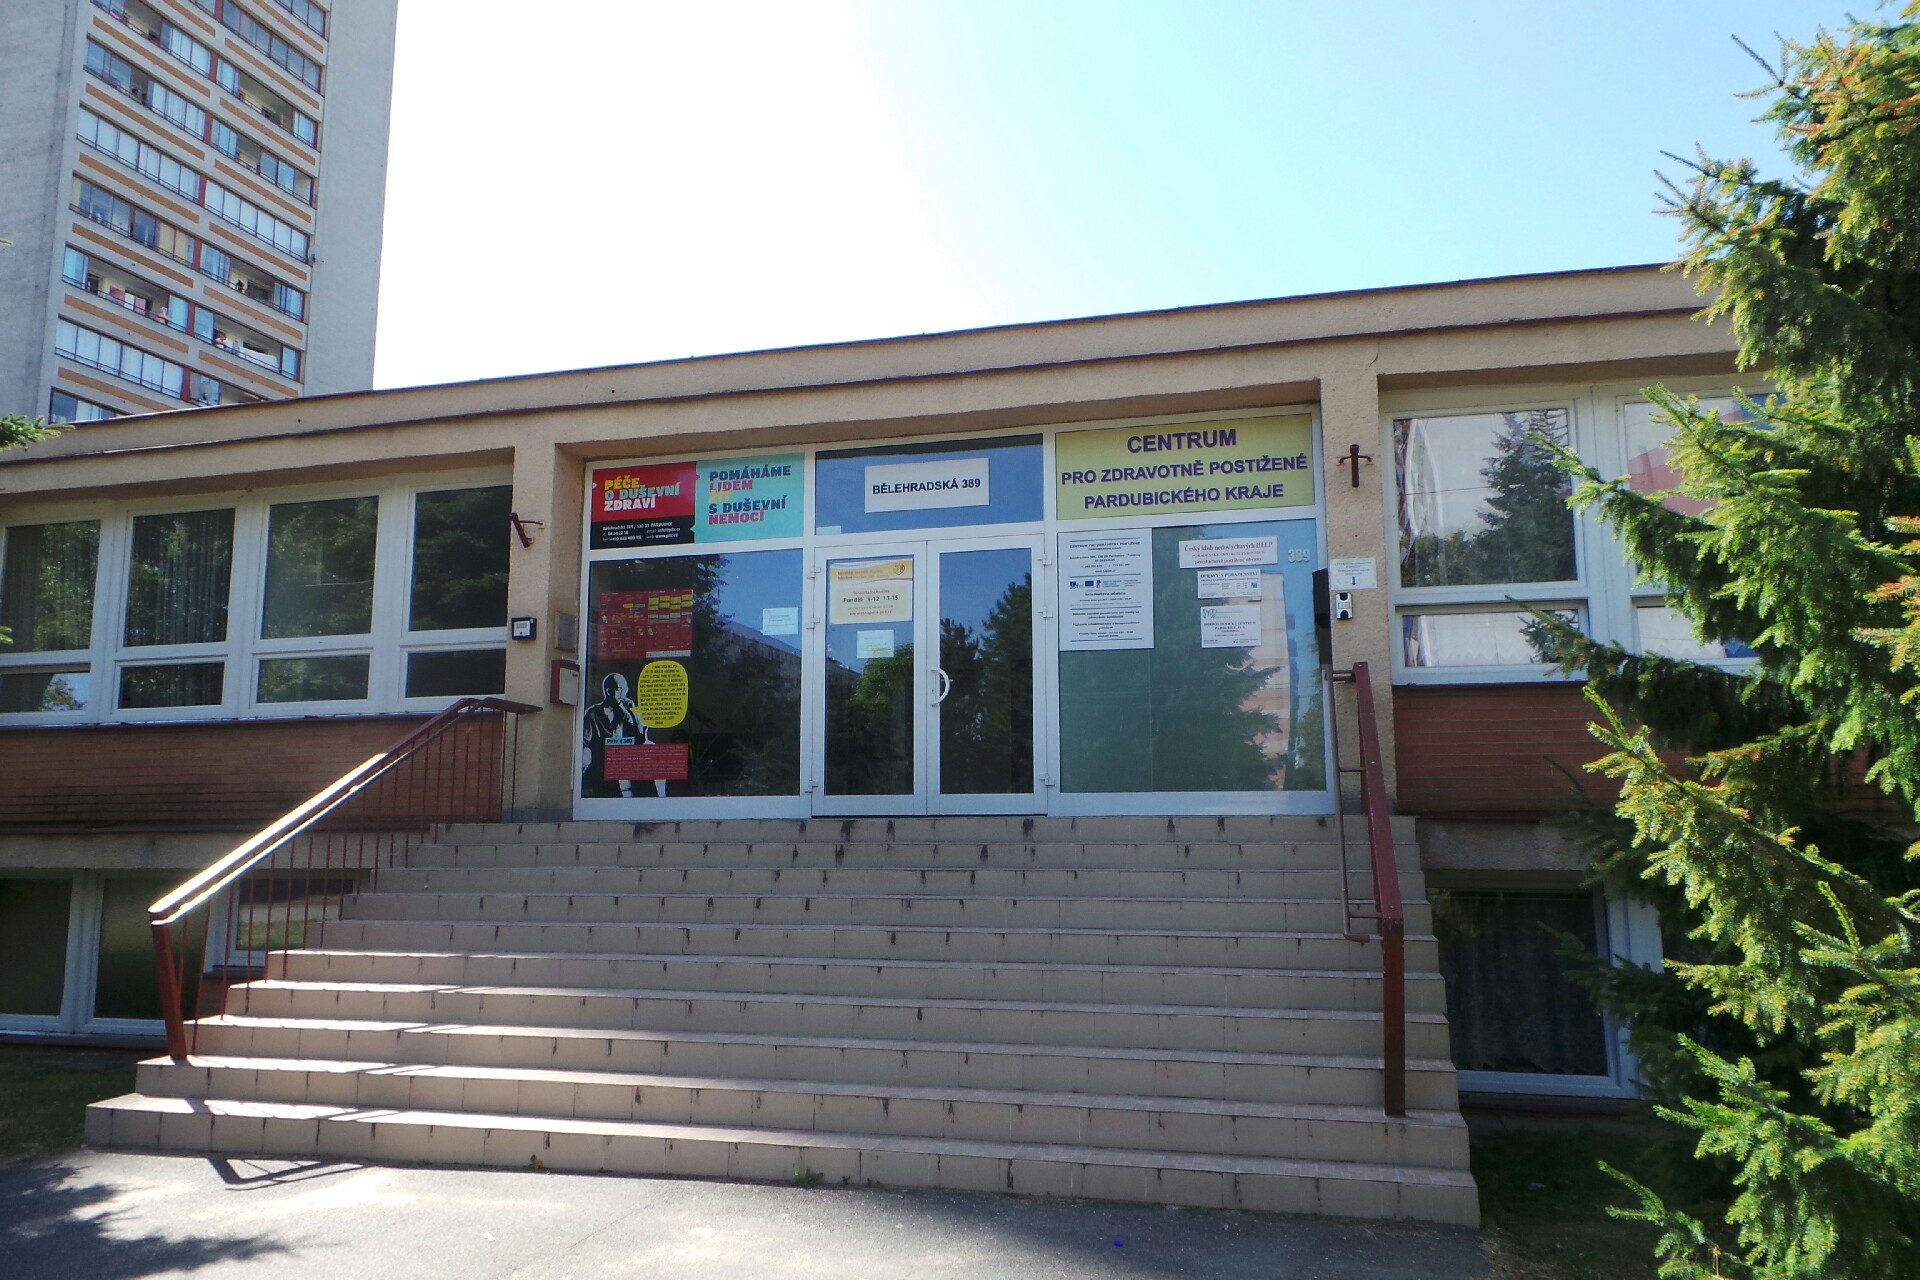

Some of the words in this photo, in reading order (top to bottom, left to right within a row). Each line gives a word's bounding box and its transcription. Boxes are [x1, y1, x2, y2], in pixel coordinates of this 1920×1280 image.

[1127, 428, 1237, 453] CENTRUM
[709, 463, 791, 482] POMÁHÁME
[1061, 469, 1097, 485] PRO
[1101, 459, 1205, 483] ZDRAVOTNĚ
[1209, 452, 1308, 475] POSTIŽENÉ
[604, 475, 640, 490] PÉČE
[604, 489, 615, 500] O
[619, 481, 681, 500] DUŠEVNÍ
[709, 479, 753, 493] LIDEM
[872, 478, 958, 495] BĚLEHRADSKÁ
[962, 478, 981, 489] 389
[603, 494, 657, 511] ZDRAVÍ
[708, 503, 718, 514] S
[722, 495, 788, 514] DUŠEVNÍ
[1084, 486, 1221, 509] PARDUBICKÉHO
[1225, 483, 1284, 500] KRAJE
[708, 508, 765, 525] NEMOCÍ
[1287, 548, 1311, 563] 389
